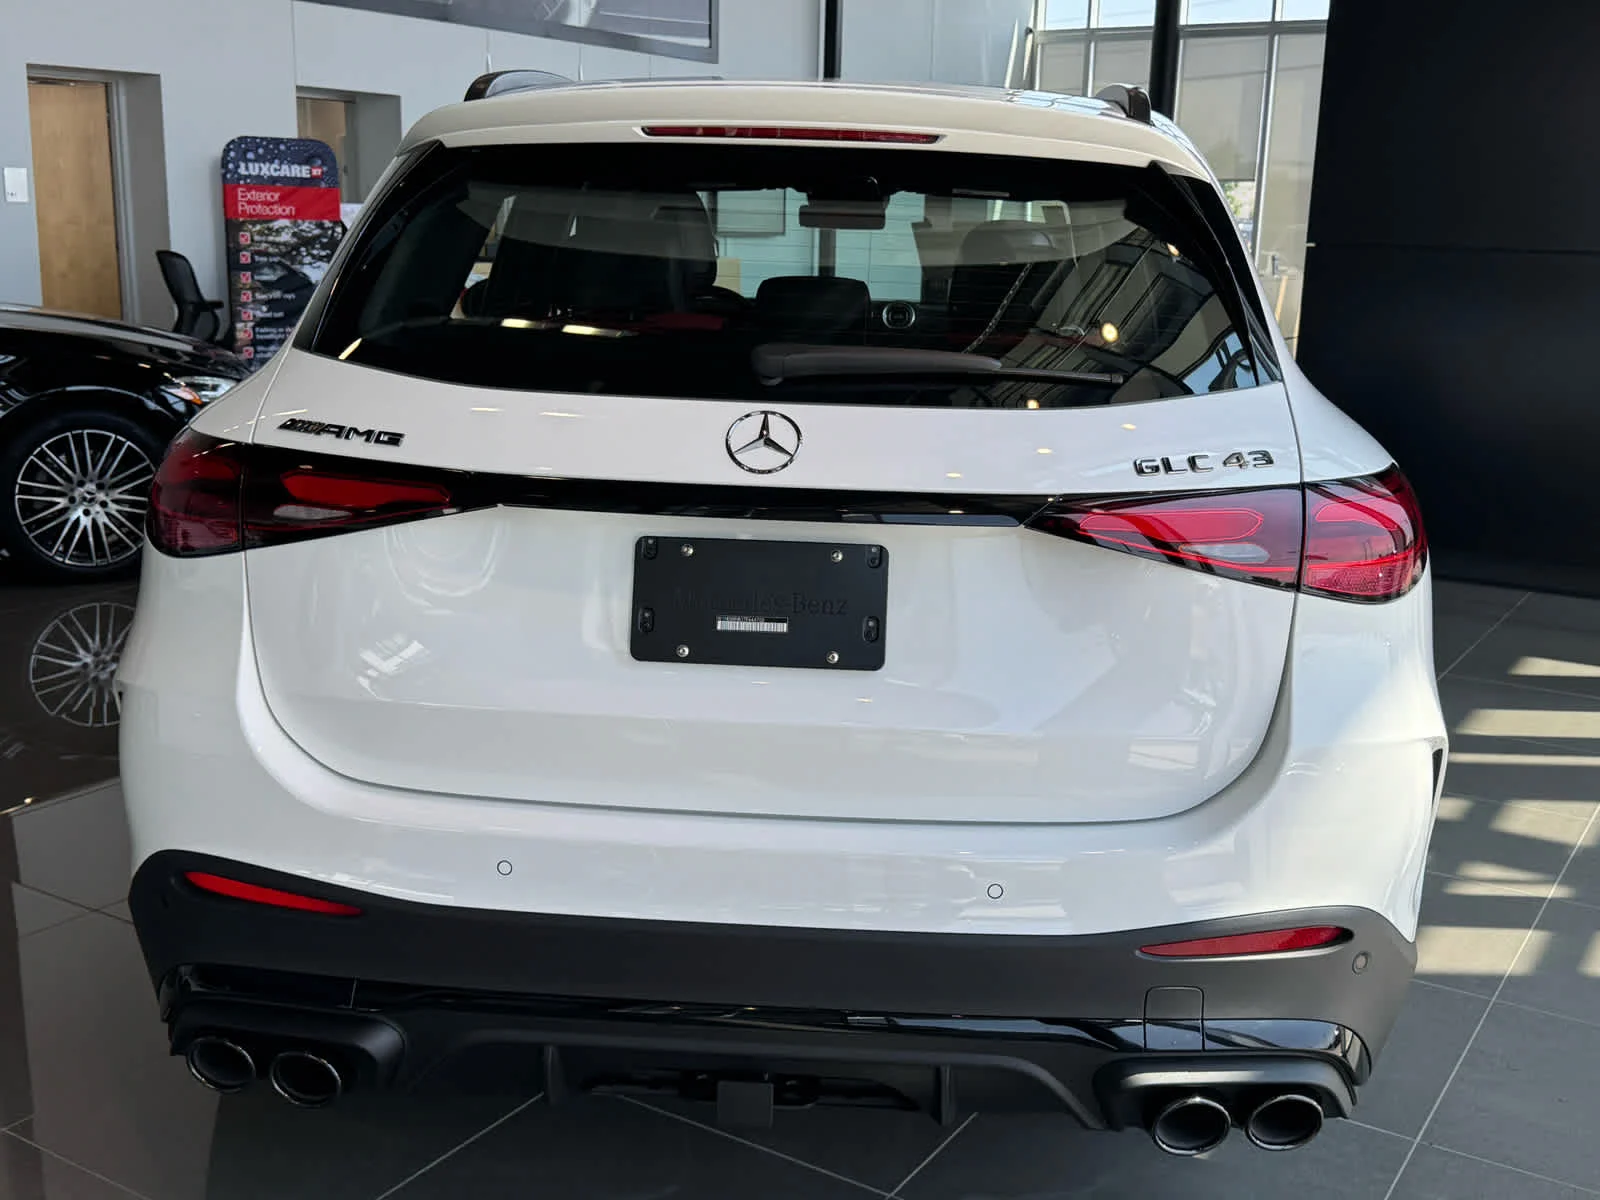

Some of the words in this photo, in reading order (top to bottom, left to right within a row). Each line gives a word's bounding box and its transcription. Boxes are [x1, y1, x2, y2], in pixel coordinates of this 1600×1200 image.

[239, 161, 312, 178] LUXCARE
[237, 187, 281, 202] Exterior
[238, 202, 297, 217] Protection
[314, 422, 405, 447] AMG
[1133, 453, 1214, 477] GLC
[1222, 450, 1275, 469] 43
[671, 587, 849, 616] Mdes-Benz
